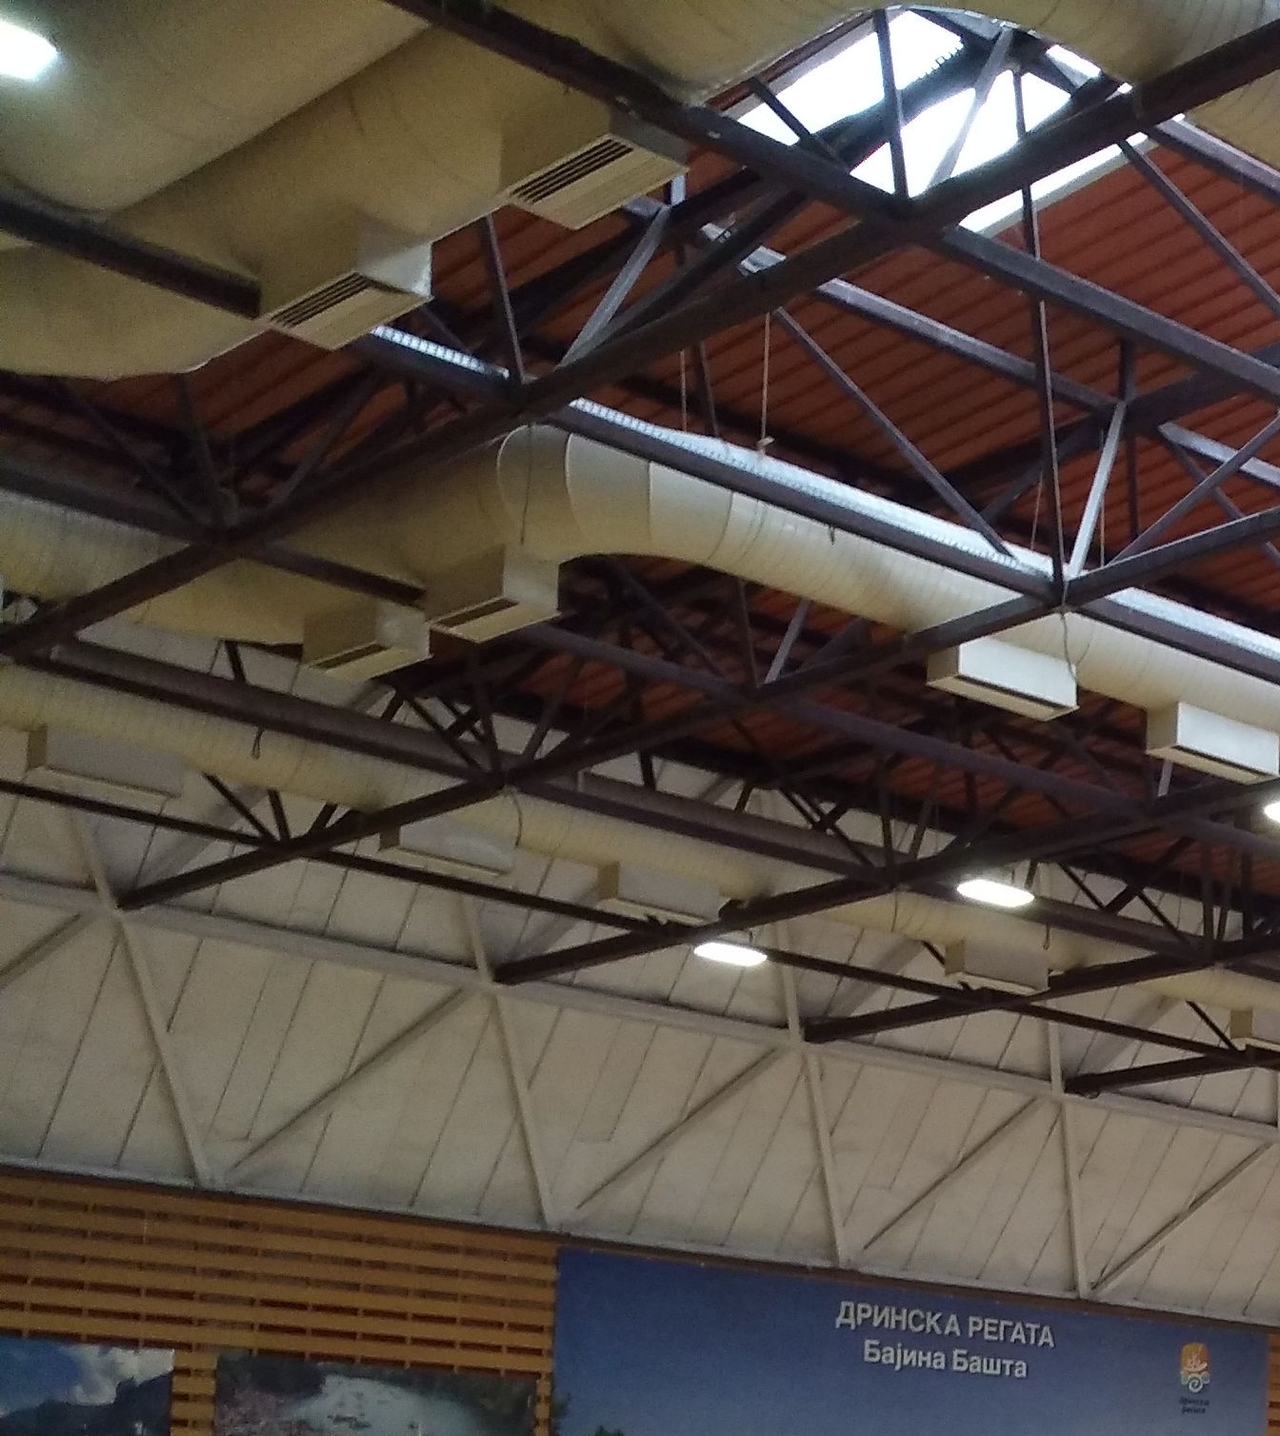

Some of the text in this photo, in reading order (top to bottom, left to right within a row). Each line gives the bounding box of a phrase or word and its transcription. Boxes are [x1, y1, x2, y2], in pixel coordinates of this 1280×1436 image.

[835, 1301, 1055, 1349] ДРИНСКА РЕГАТА
[863, 1339, 1028, 1379] Бајина Башта
